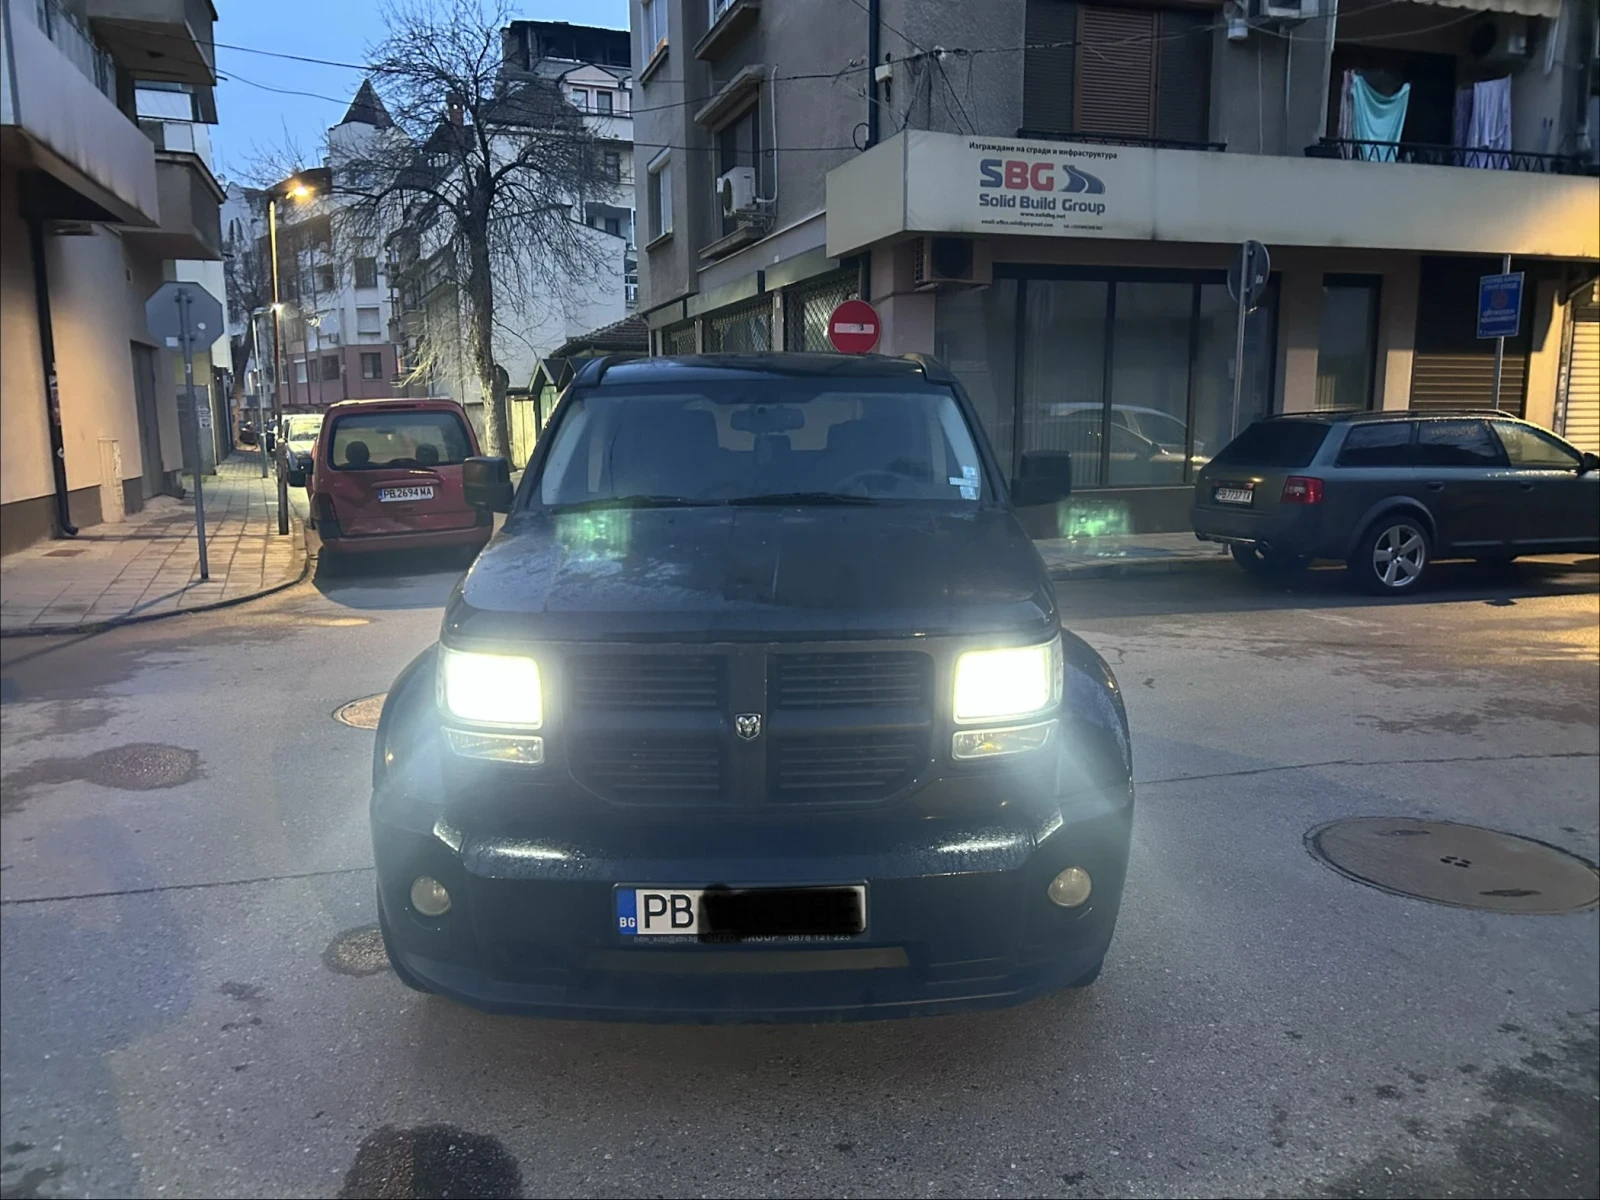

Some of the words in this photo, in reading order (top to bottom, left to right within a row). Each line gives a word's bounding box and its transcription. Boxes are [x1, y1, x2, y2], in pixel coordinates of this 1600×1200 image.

[969, 142, 1015, 152] Изграждане
[1026, 147, 1051, 155] сгради
[1058, 149, 1118, 160] инфраструктура
[979, 158, 1054, 192] SBG
[979, 193, 1016, 208] Solid
[1019, 196, 1056, 210] Build
[1061, 199, 1106, 216] Group
[619, 917, 636, 928] BG
[643, 893, 694, 929] PB
